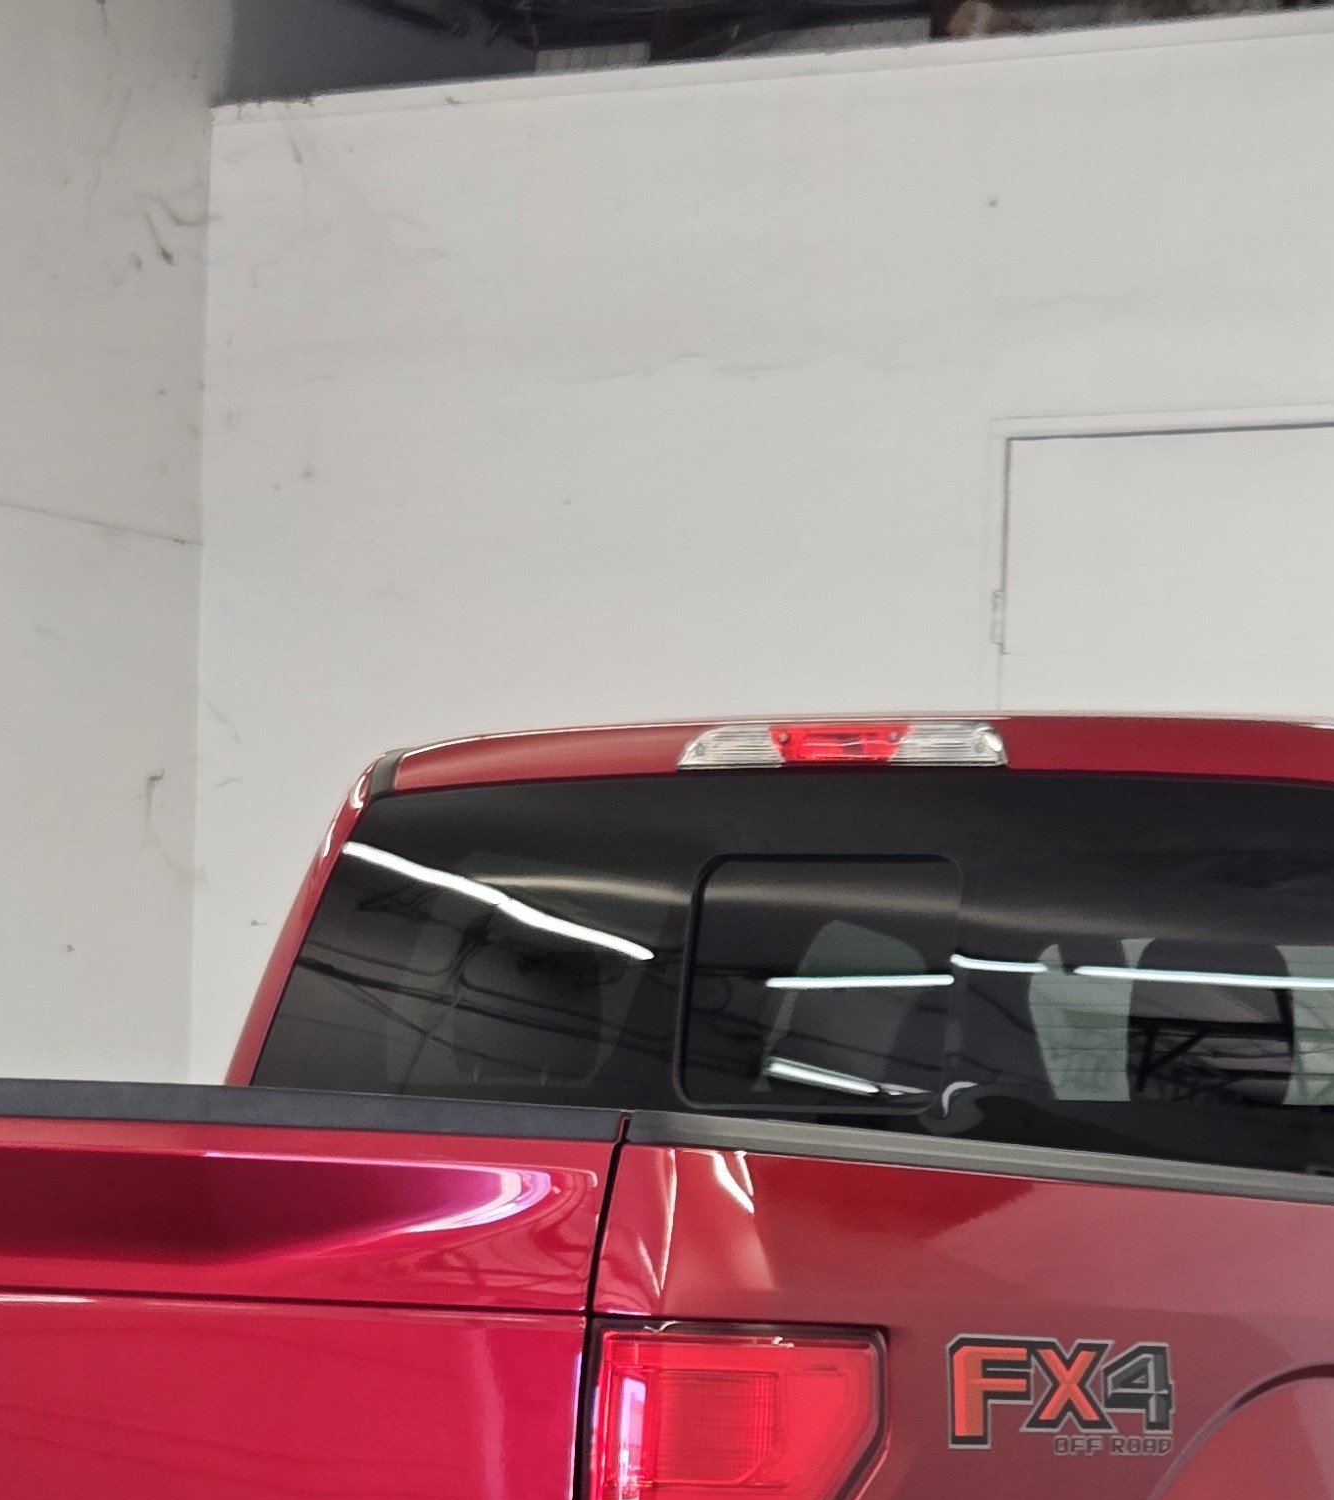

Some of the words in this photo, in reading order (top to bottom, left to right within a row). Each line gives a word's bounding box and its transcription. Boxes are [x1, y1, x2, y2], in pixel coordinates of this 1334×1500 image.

[946, 1333, 1174, 1449] FX4
[1054, 1435, 1103, 1456] OFF
[1110, 1435, 1174, 1456] ROAD
